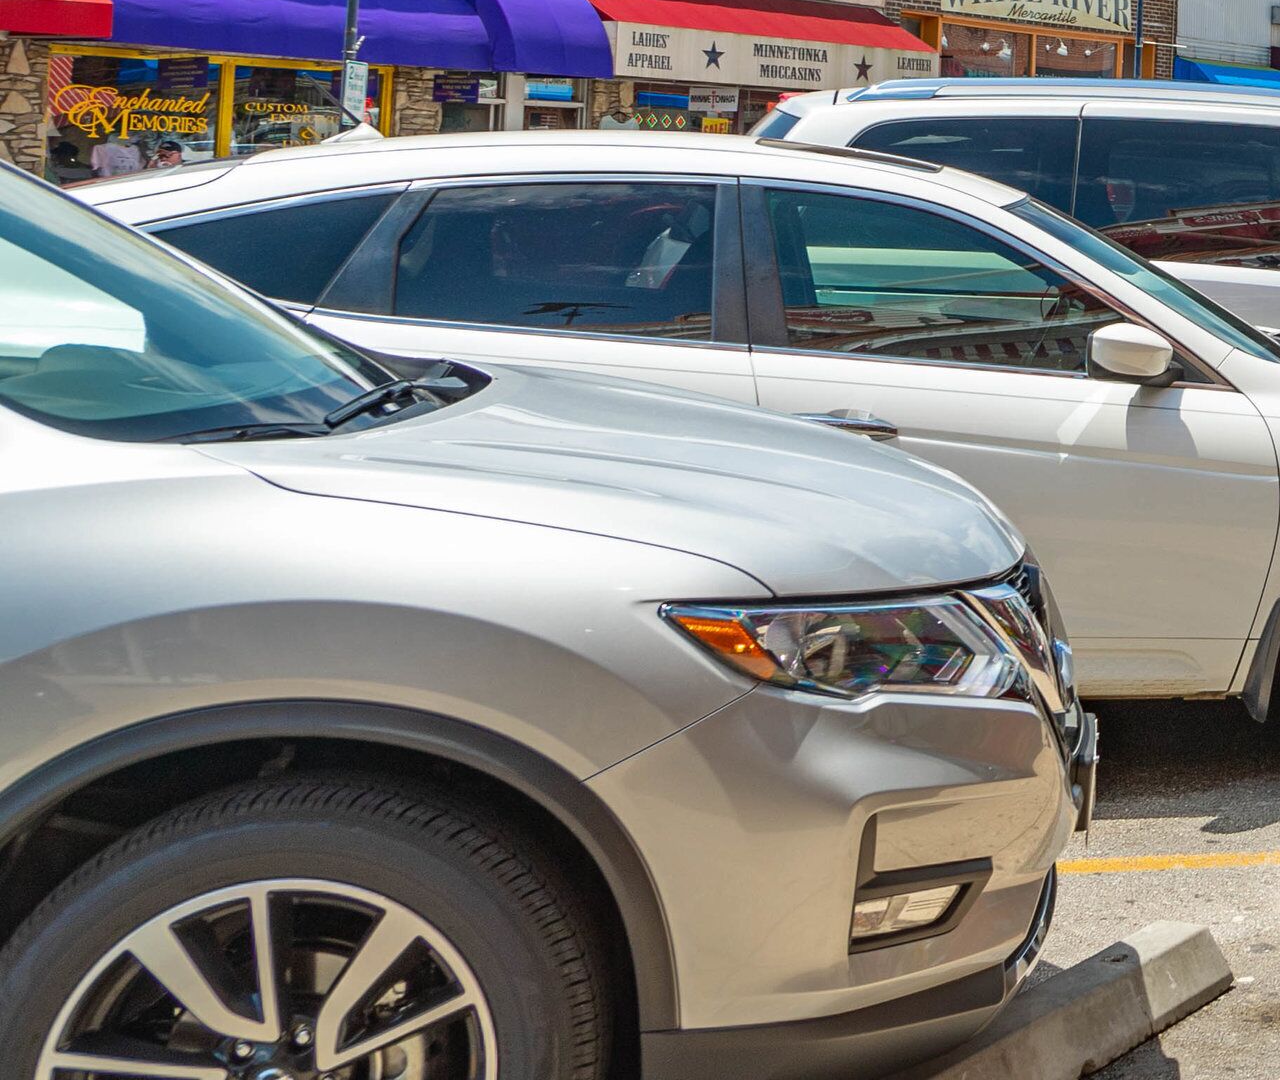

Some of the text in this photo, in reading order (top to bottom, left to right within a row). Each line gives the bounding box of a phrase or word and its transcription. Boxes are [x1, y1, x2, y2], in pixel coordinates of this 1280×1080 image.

[1007, 2, 1079, 25] Mercantile
[631, 30, 670, 49] LADIES'
[626, 51, 673, 72] APPAREL
[752, 42, 829, 64] MINNETONKA
[759, 63, 822, 83] MOCCASINS
[896, 56, 932, 72] LEATHER
[54, 84, 211, 114] Enchanted
[245, 101, 309, 113] CUSTOM
[67, 100, 209, 139] MEMORIES
